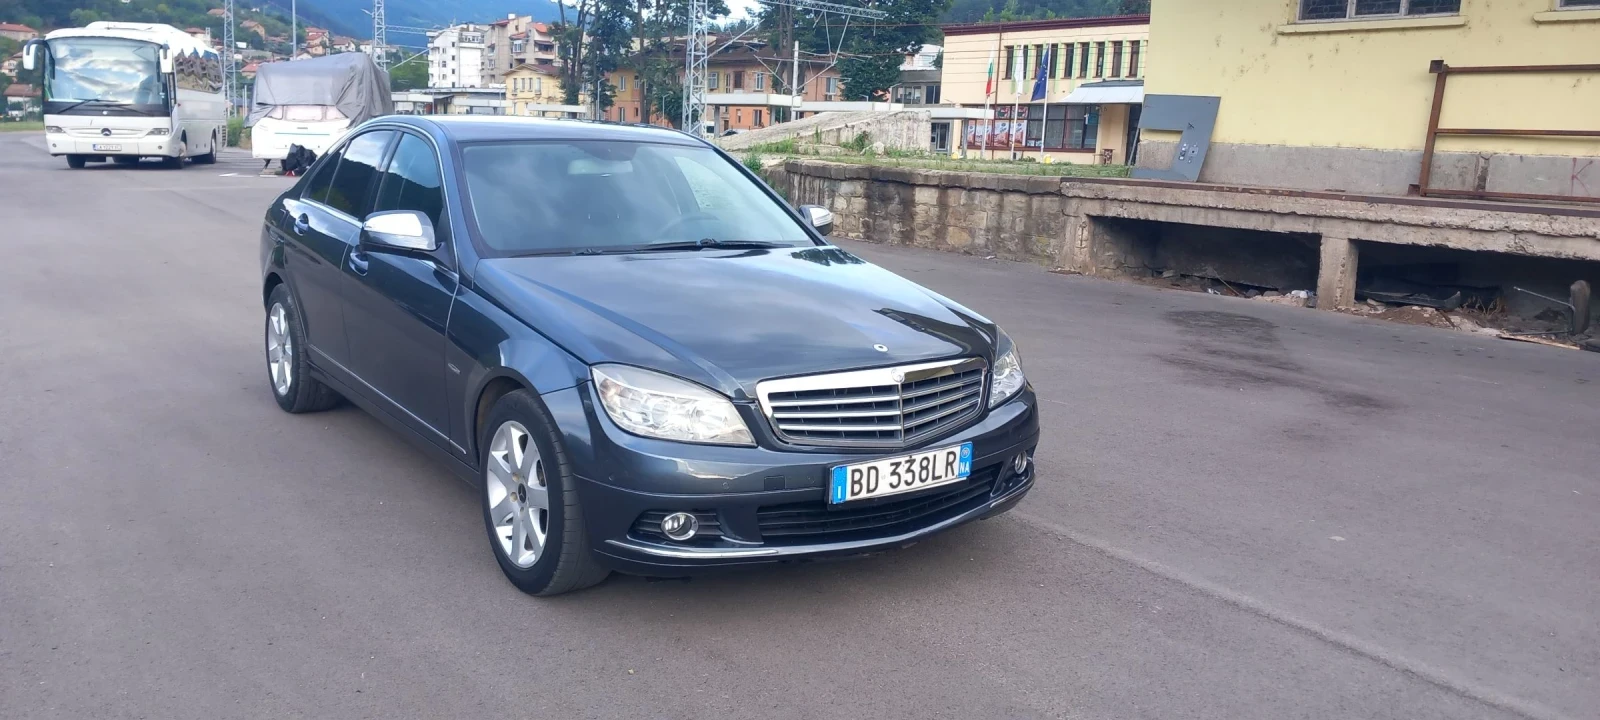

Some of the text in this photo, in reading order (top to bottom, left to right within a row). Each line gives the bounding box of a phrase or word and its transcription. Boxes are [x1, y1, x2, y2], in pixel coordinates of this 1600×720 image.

[851, 466, 879, 497] BD
[889, 451, 957, 489] 338LR
[960, 461, 970, 474] NA
